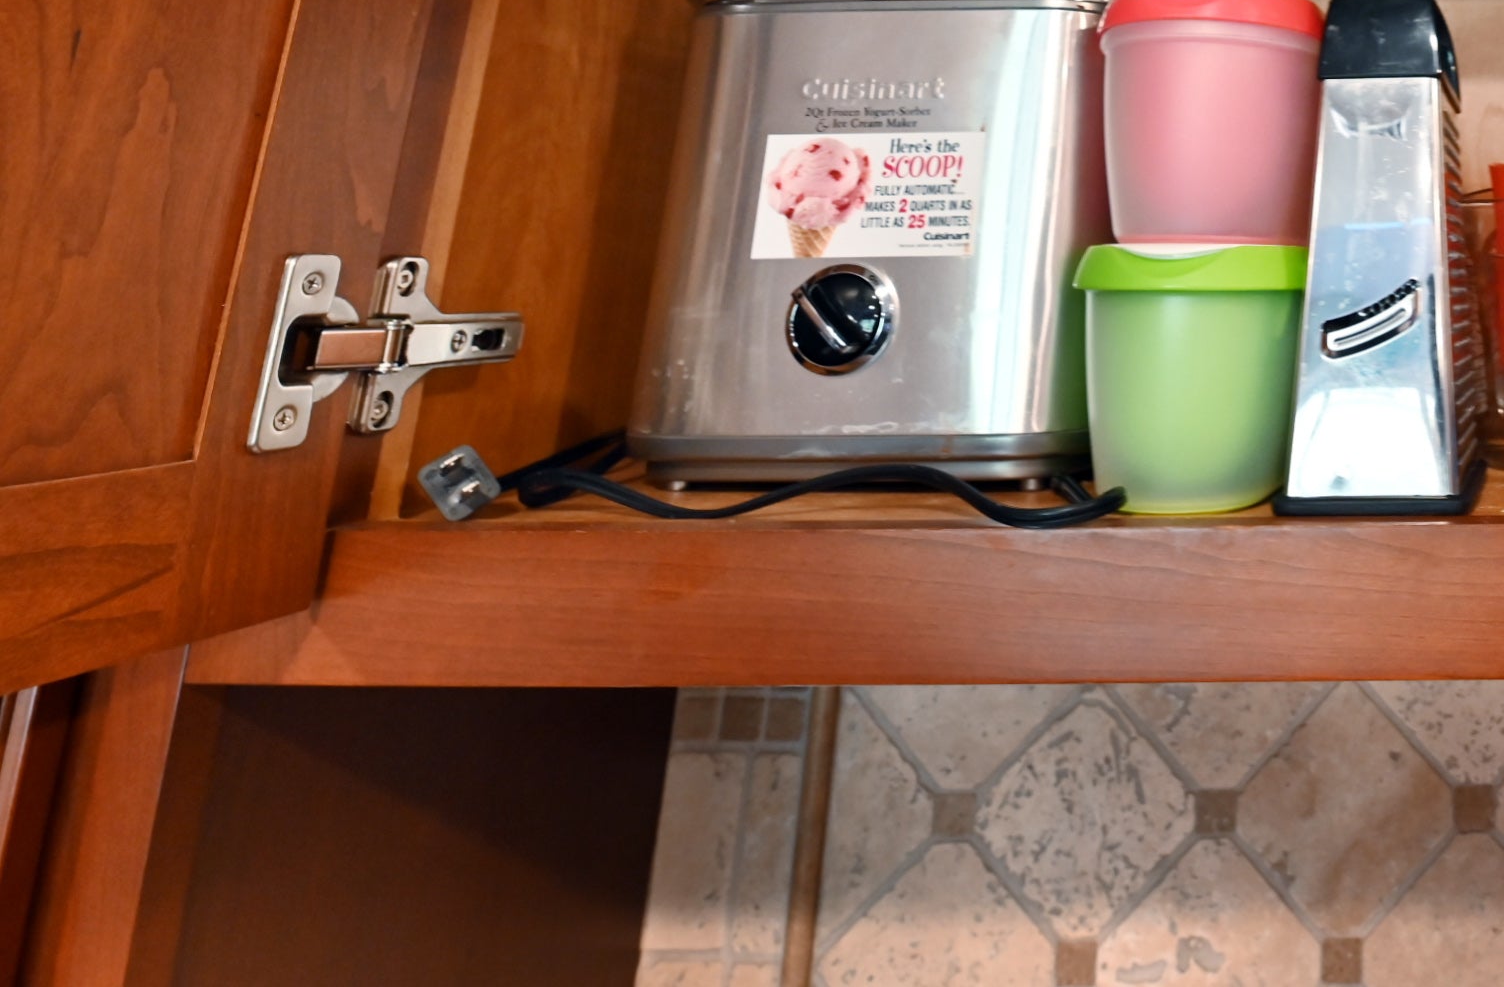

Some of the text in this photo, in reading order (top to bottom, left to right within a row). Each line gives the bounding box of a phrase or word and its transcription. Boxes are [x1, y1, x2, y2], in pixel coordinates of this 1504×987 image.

[832, 119, 847, 128] Ice
[850, 118, 883, 128] Cream
[885, 118, 918, 128] Maker
[889, 138, 961, 153] Here's the
[881, 154, 964, 179] SCOOP!
[874, 185, 901, 196] FULLY
[864, 198, 972, 213] MAKES 2 QUARTS IN AS
[860, 214, 971, 229] LITTLE AS 25 MINUTES.
[923, 231, 970, 241] Cuisinart
